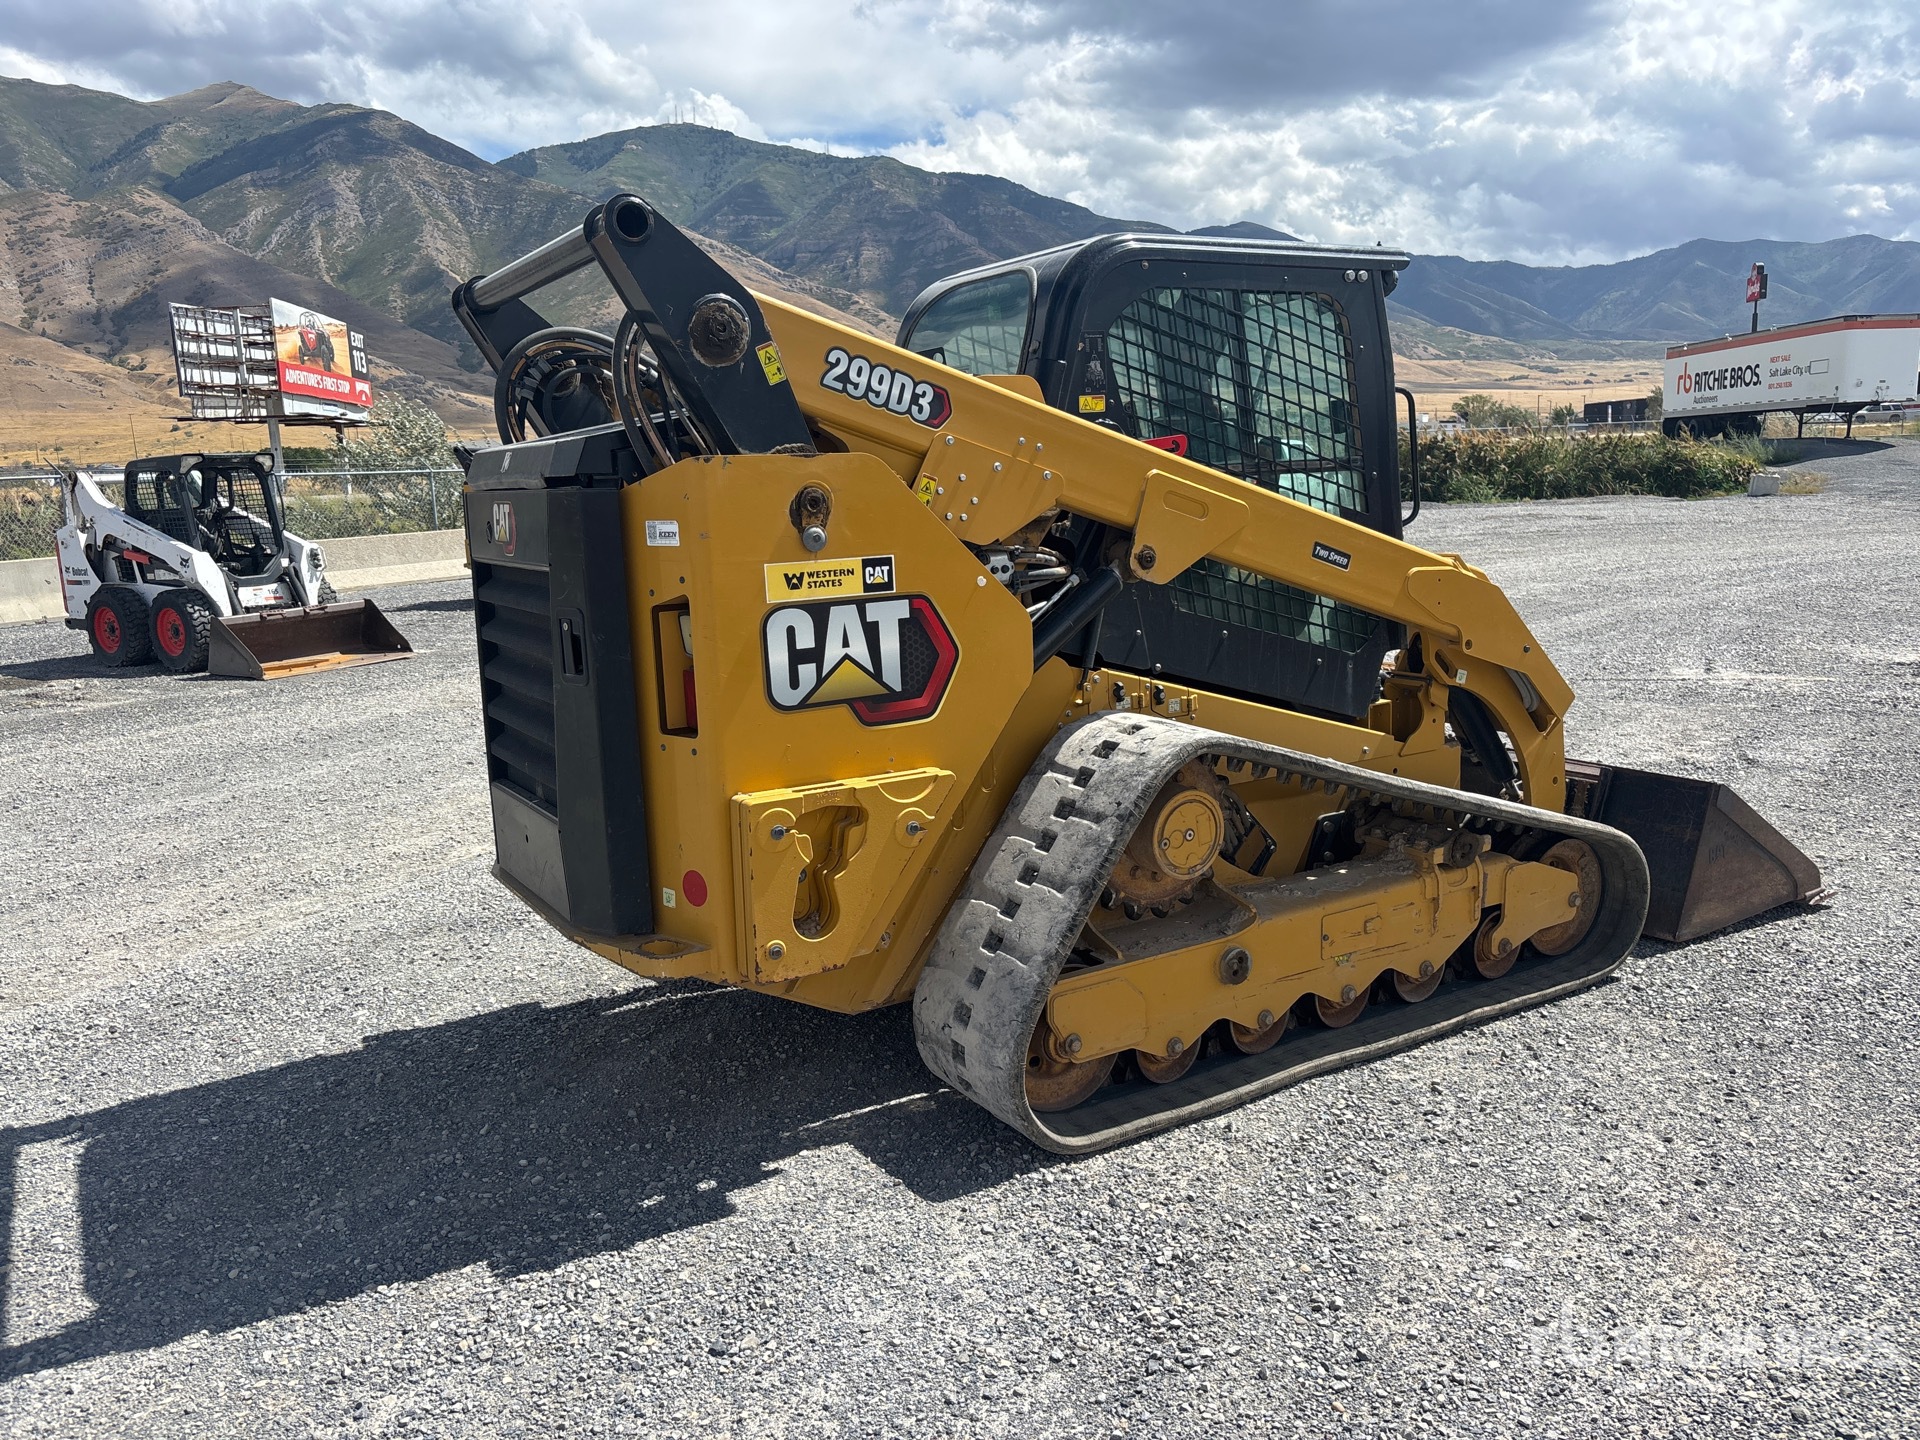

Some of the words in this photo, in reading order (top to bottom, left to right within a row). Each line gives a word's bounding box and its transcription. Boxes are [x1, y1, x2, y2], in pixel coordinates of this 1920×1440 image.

[350, 331, 364, 349] EXIT
[352, 349, 367, 374] 113
[1769, 355, 1780, 364] NEXT
[1780, 354, 1791, 362] SALE
[1693, 367, 1729, 393] RITCHIE
[1729, 363, 1762, 389] BROS.
[1769, 367, 1779, 377] Salt
[1779, 366, 1791, 376] Lake
[285, 368, 323, 389] ADVENTURE'S
[323, 376, 337, 392] FIRST
[337, 379, 351, 394] STOP
[822, 349, 934, 421] 299D3
[1693, 394, 1718, 404] Auctioneers
[493, 503, 510, 542] CAT
[71, 566, 89, 577] Bobcat
[807, 568, 855, 579] WESTERN
[865, 565, 890, 584] CAT
[807, 579, 843, 589] STATES
[766, 599, 910, 706] CAT
